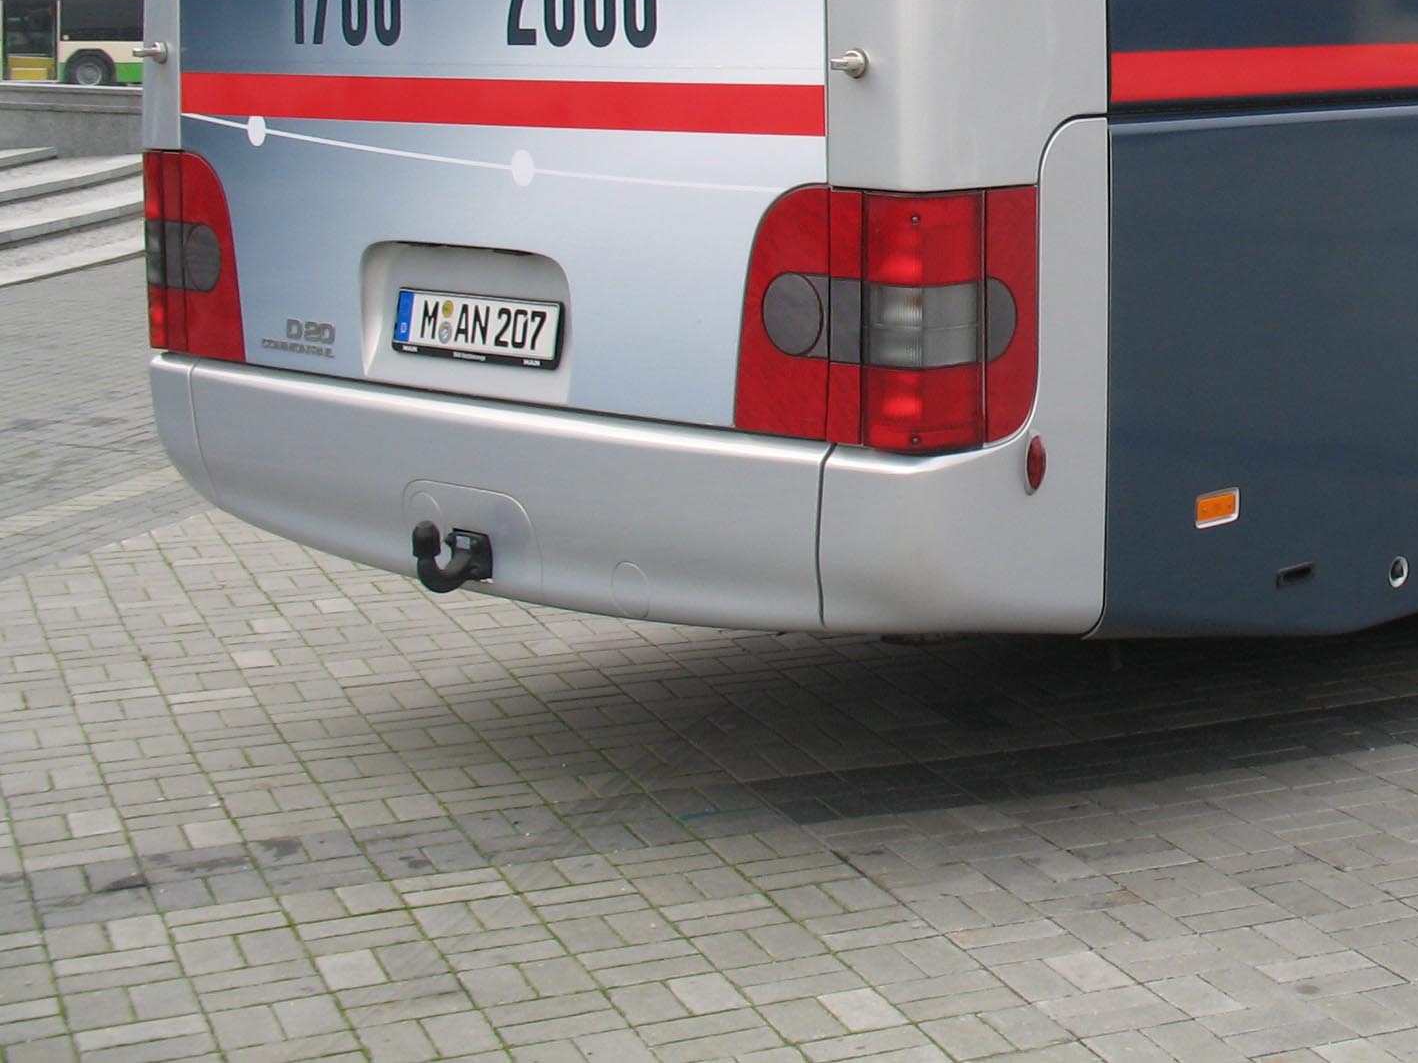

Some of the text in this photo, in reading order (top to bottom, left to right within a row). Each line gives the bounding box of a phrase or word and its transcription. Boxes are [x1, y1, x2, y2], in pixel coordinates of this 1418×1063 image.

[420, 299, 548, 351] M AN 207
